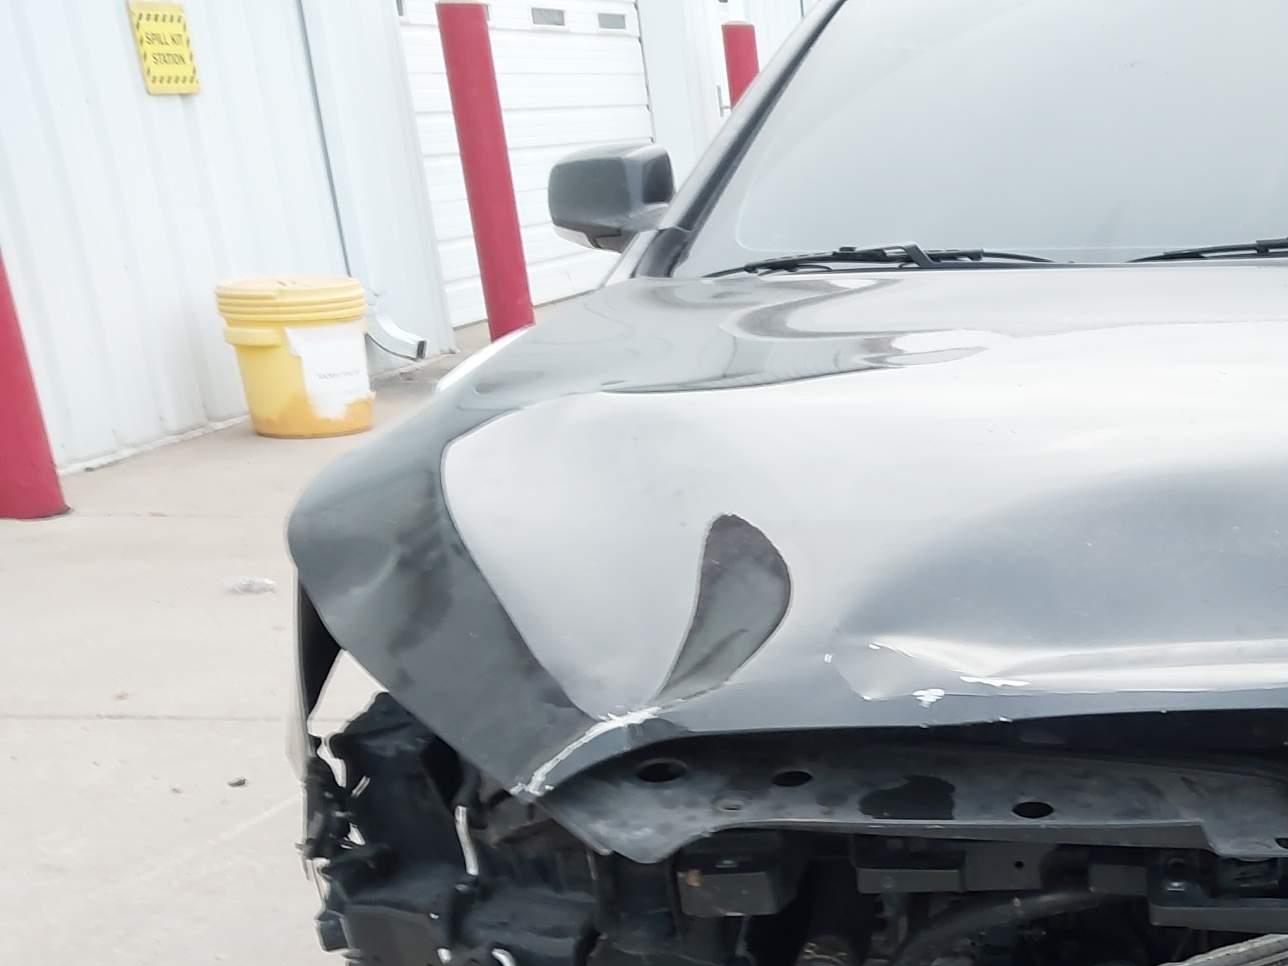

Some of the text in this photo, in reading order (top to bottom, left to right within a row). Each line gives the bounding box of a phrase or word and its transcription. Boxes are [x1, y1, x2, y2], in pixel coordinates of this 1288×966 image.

[144, 32, 183, 45] SPILL KIT
[152, 53, 186, 65] STATION
